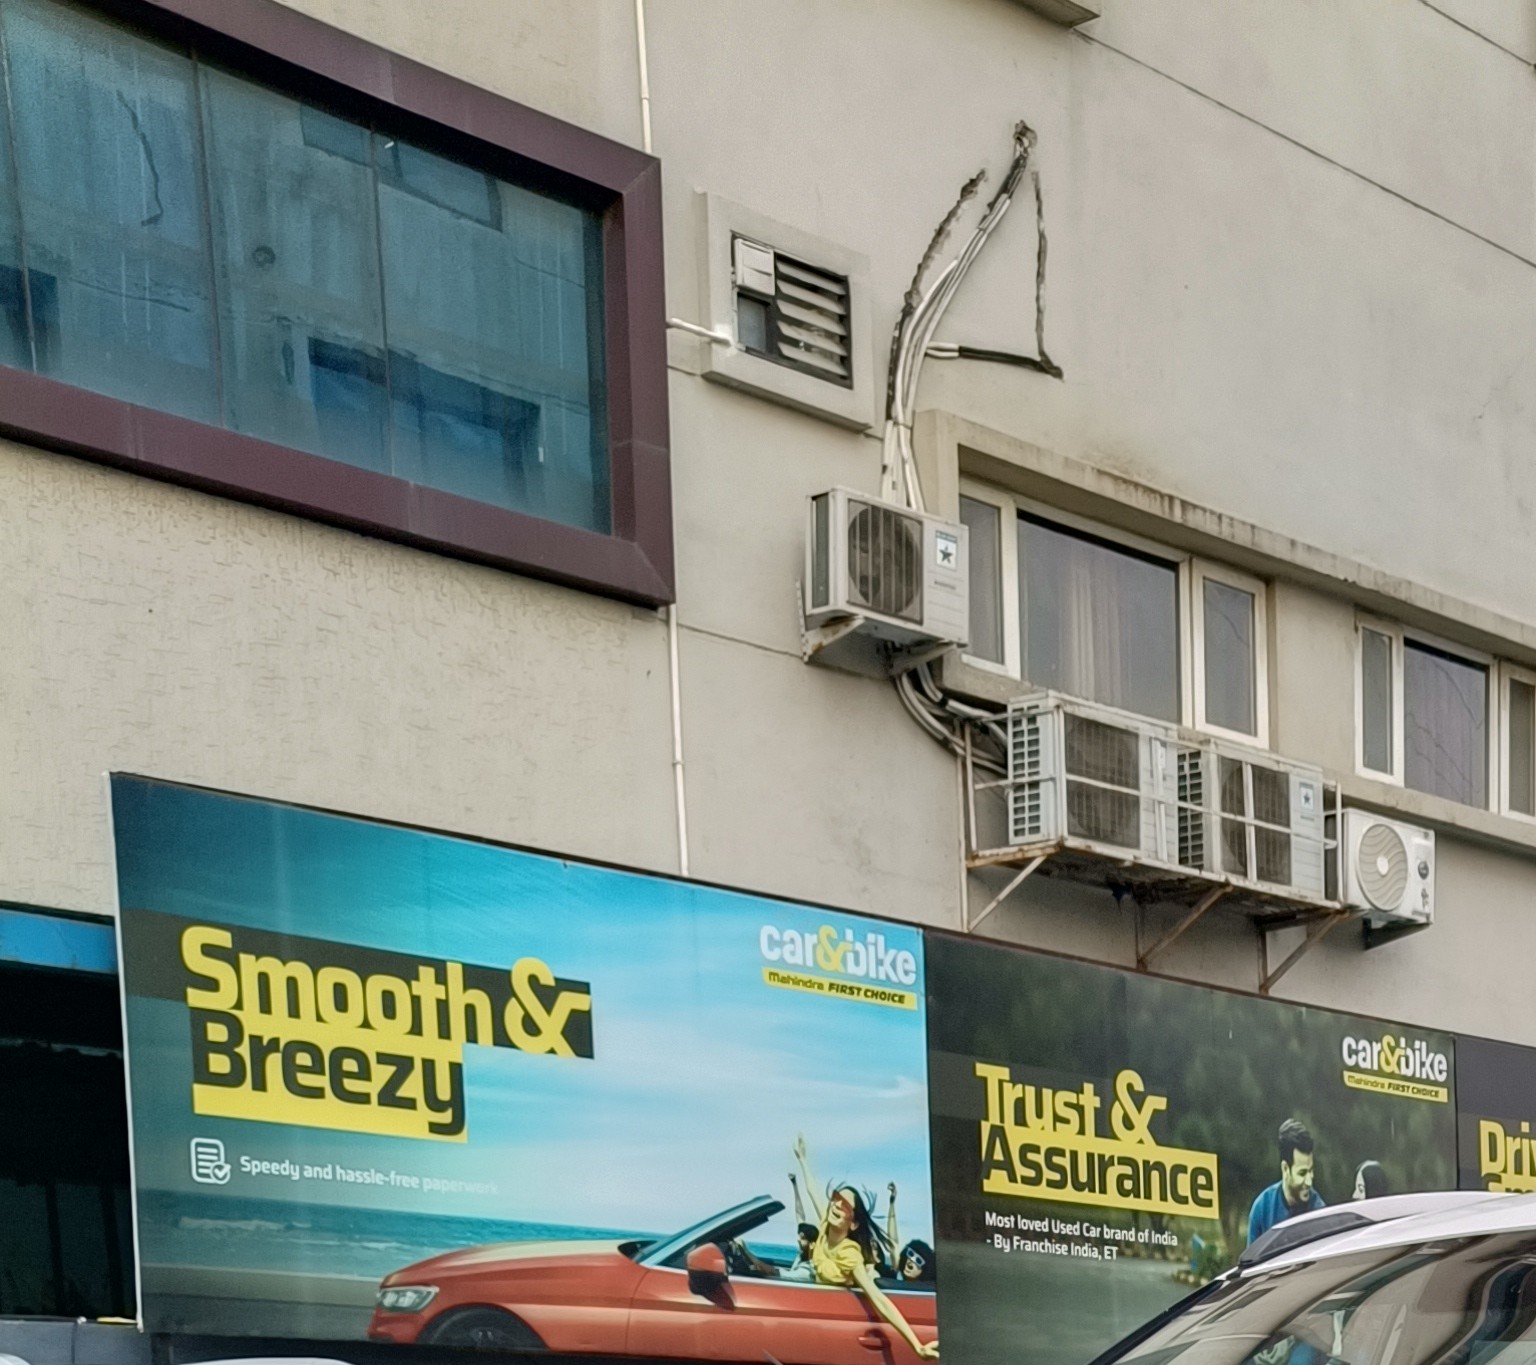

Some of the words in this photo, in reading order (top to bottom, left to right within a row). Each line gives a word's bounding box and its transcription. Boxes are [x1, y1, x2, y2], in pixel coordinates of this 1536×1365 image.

[760, 924, 917, 986] car&bike
[181, 925, 493, 1046] Smooth
[504, 957, 591, 1057] &
[828, 982, 862, 997] FIRST
[863, 988, 906, 1004] CHOICE
[190, 1009, 467, 1137] Breezy
[1342, 1034, 1448, 1083] car&bike
[975, 1062, 1101, 1138] Trust
[1111, 1069, 1168, 1146] &
[239, 1156, 300, 1181] Speedy
[303, 1164, 333, 1180] and
[336, 1165, 420, 1189] hassle-free
[980, 1124, 1215, 1208] Assurance
[984, 1211, 1015, 1229] Most
[1017, 1214, 1049, 1233] loved
[1051, 1219, 1080, 1236] Used
[1082, 1222, 1102, 1239] Car
[1103, 1224, 1136, 1242] brand
[1137, 1229, 1150, 1244] of
[1151, 1232, 1179, 1247] India
[993, 1234, 1011, 1253] By
[1013, 1236, 1069, 1256] Franchise
[1070, 1242, 1102, 1261] India,
[1103, 1246, 1119, 1260] ET
